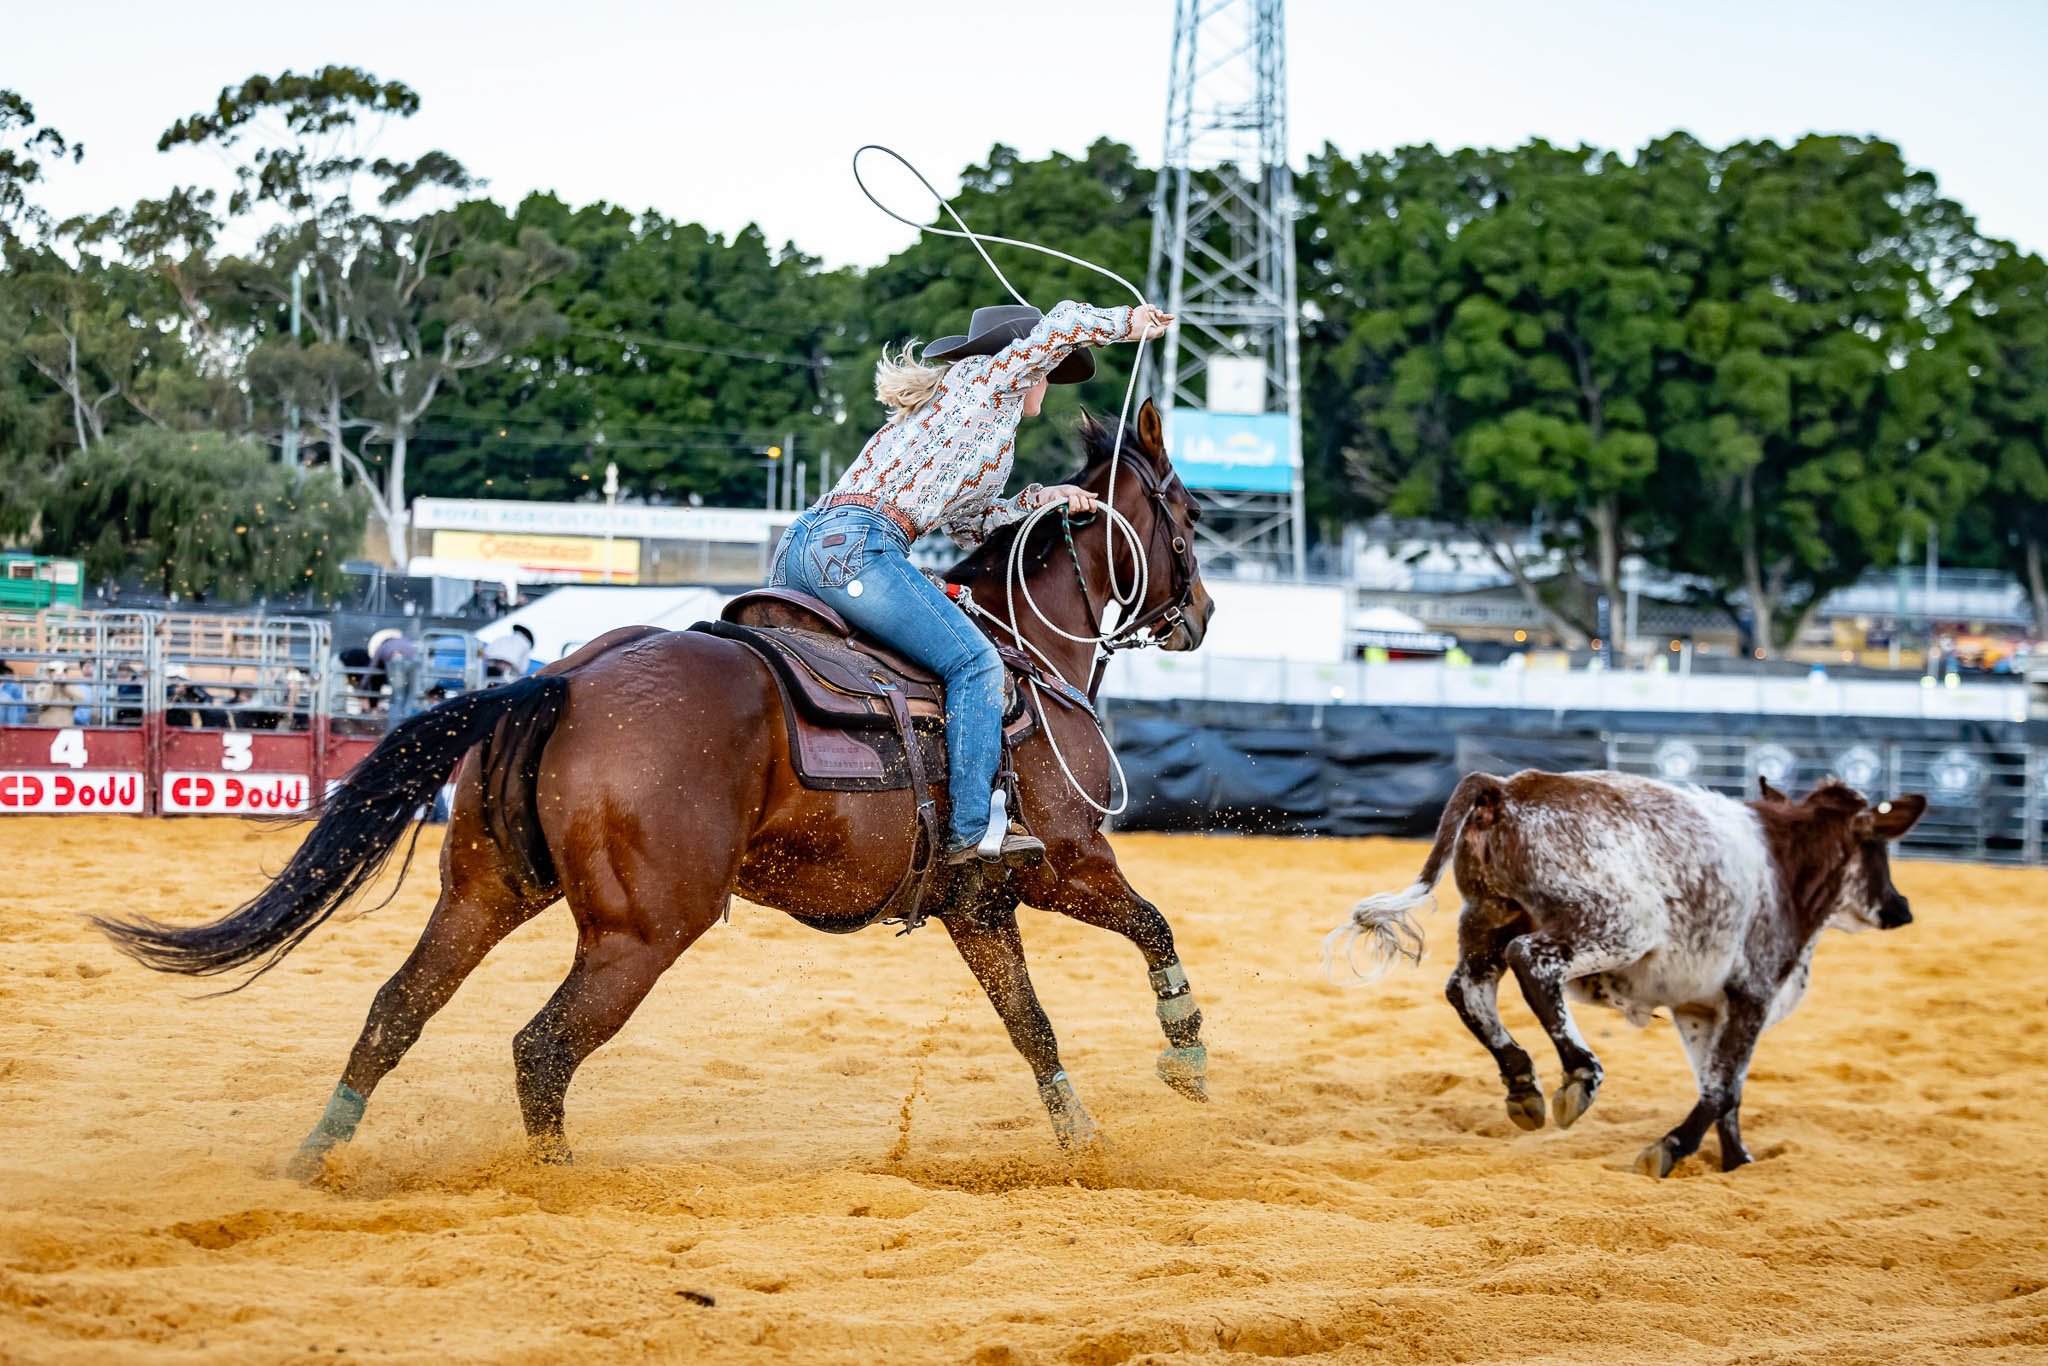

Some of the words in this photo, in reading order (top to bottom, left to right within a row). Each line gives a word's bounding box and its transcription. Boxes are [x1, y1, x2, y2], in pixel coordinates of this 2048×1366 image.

[432, 507, 490, 522] ROYAL
[50, 729, 88, 769] 4
[221, 732, 253, 771] 3
[55, 776, 135, 806] Dodd
[225, 778, 301, 808] Dodd
